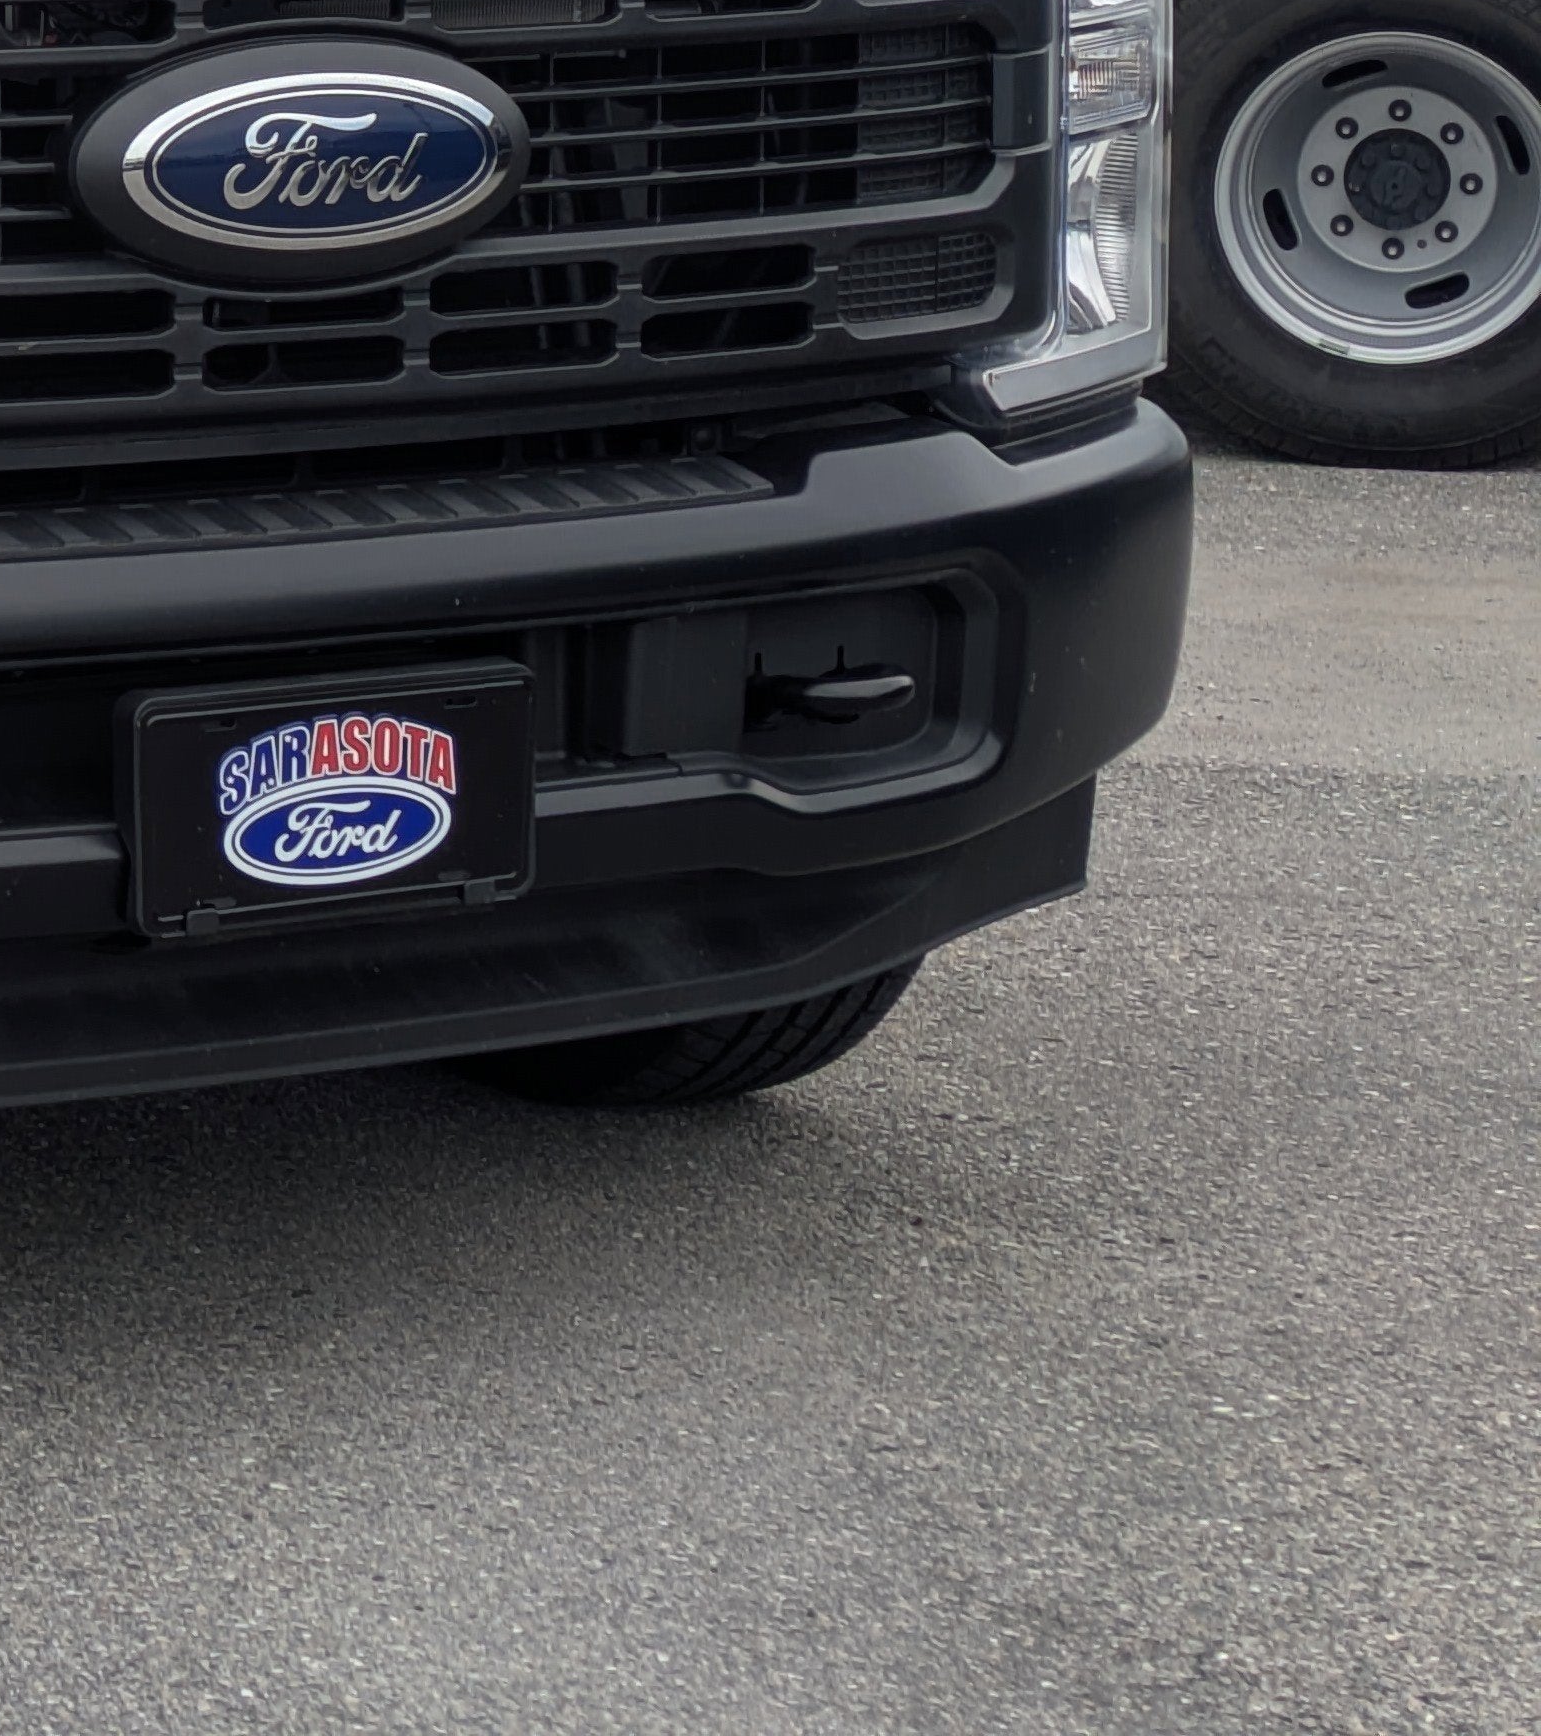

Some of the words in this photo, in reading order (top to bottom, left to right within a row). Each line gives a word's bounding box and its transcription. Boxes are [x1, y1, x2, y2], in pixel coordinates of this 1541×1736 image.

[222, 111, 429, 210] Ford
[218, 711, 458, 816] SARASOTA
[273, 799, 403, 863] Ford
